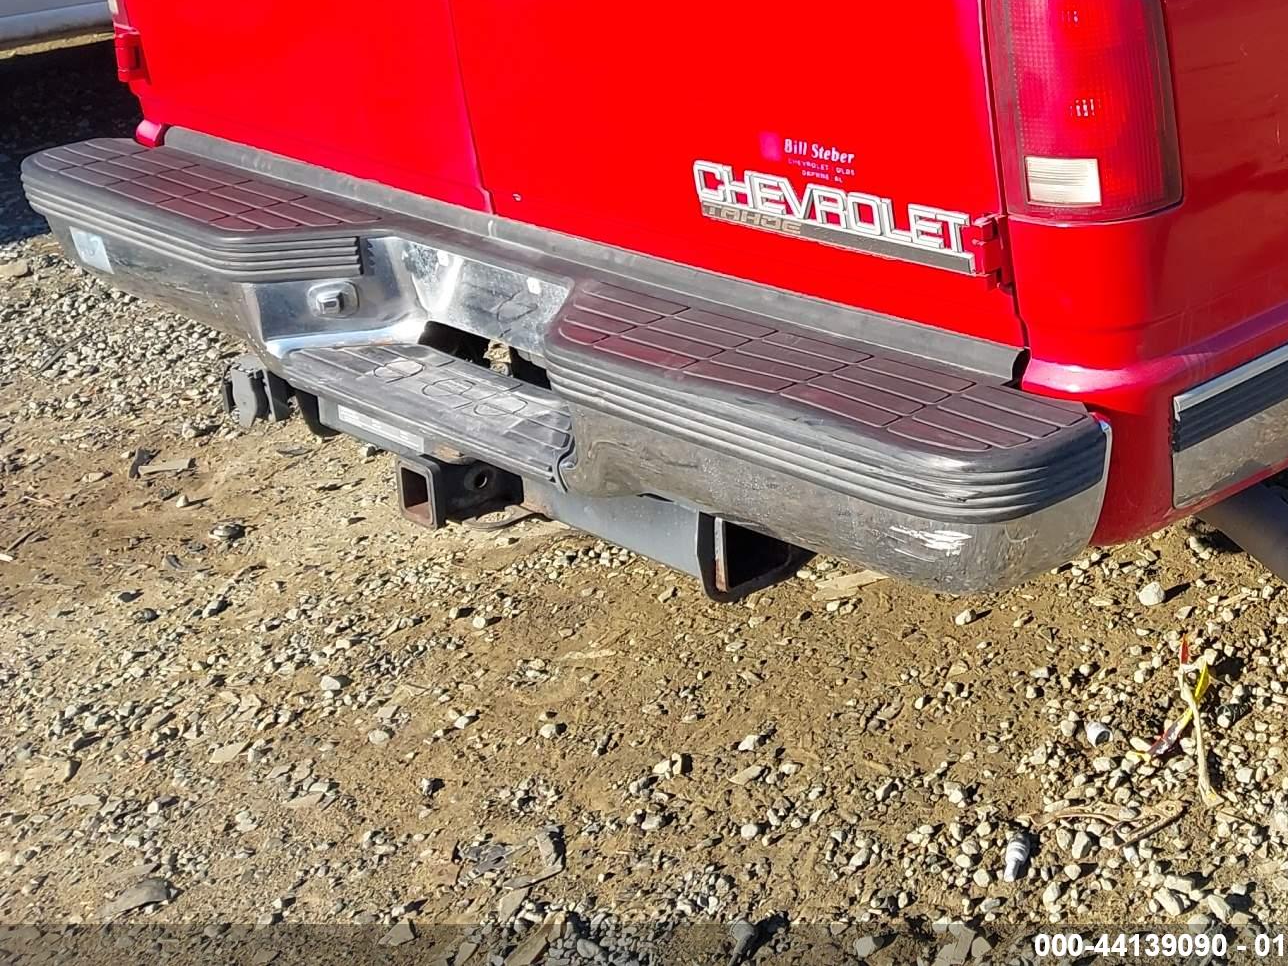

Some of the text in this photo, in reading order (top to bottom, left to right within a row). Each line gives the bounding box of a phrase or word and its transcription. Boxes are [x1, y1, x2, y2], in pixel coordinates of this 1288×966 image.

[784, 138, 856, 164] Bill Steber
[693, 159, 971, 254] CHEVROLET
[702, 201, 802, 235] TAHOE
